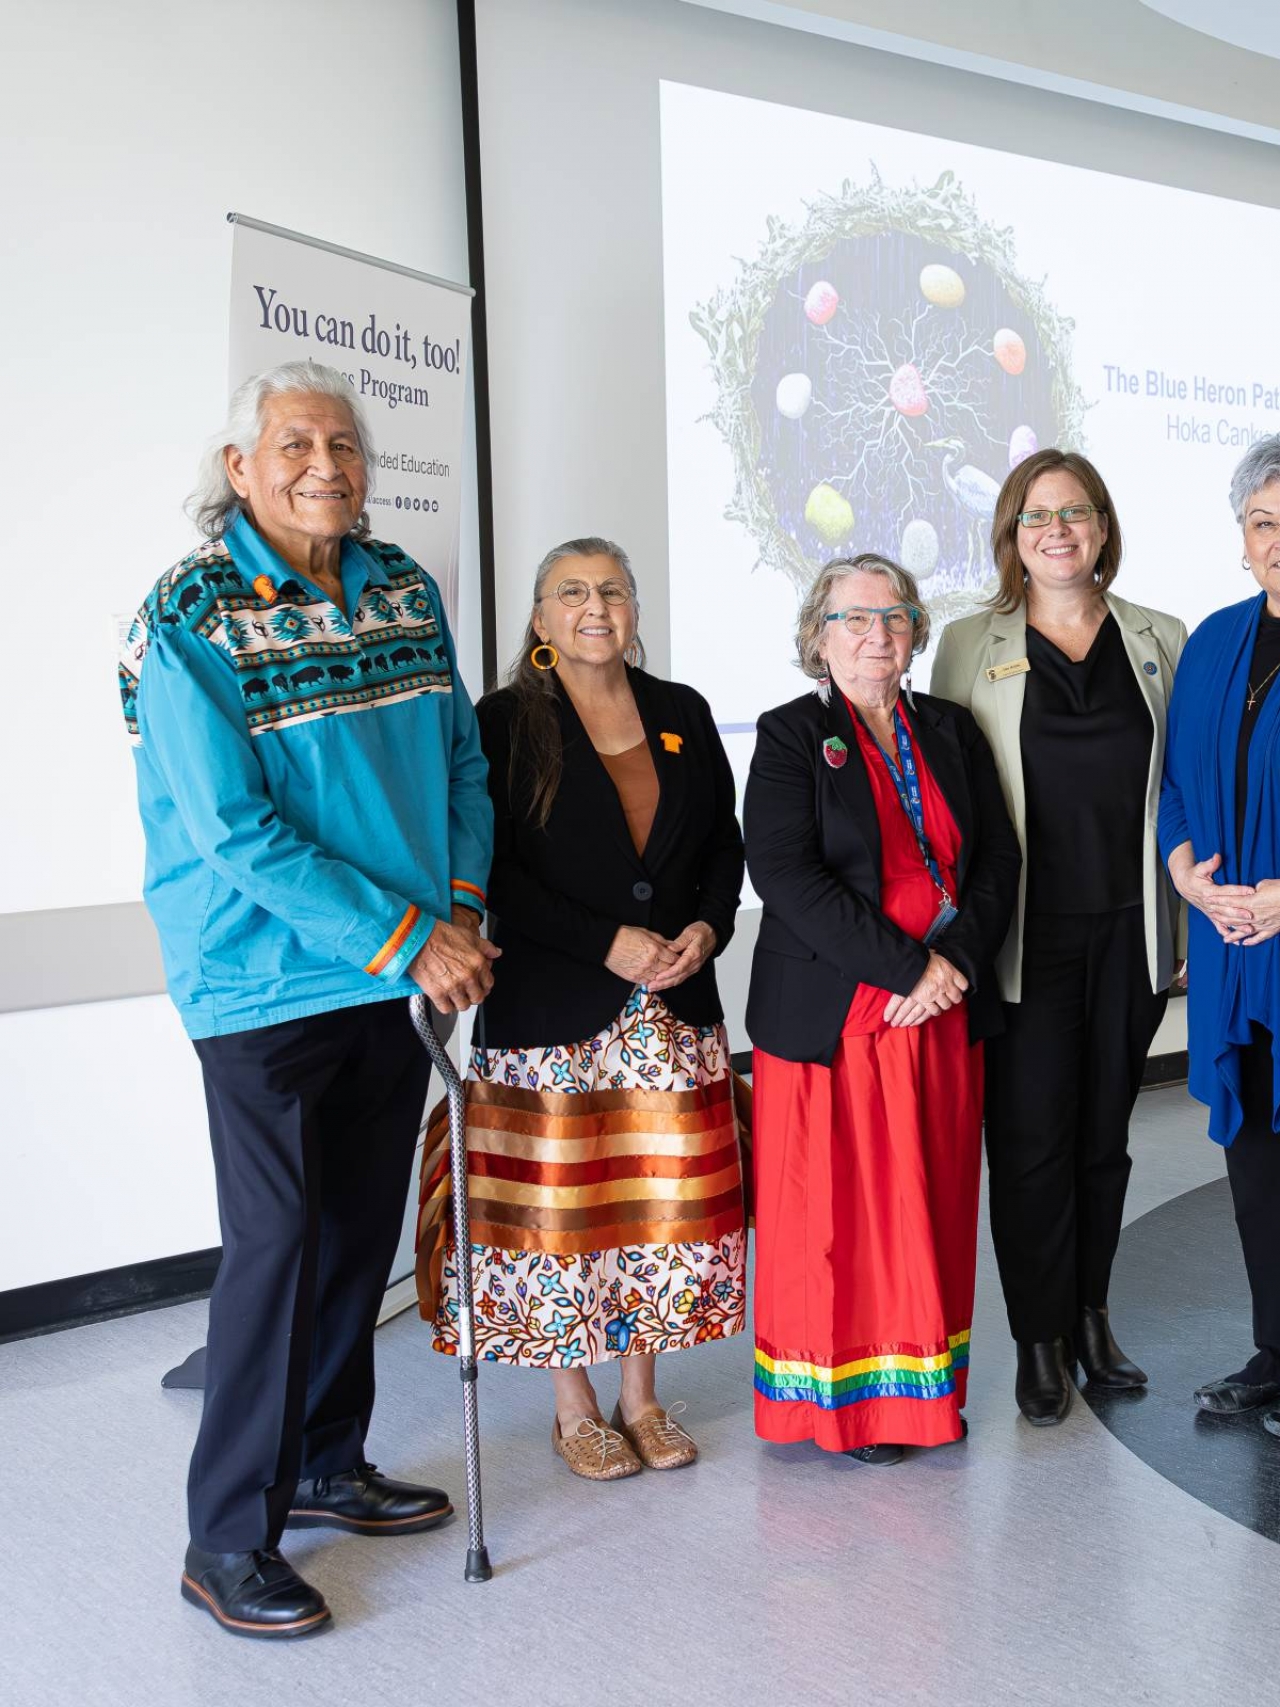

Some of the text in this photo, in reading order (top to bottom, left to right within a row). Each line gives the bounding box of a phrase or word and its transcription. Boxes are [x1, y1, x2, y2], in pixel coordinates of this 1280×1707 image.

[253, 285, 460, 374] You can do it, too!
[360, 368, 429, 409] Program
[1103, 364, 1139, 395] The
[1146, 369, 1187, 400] Blue
[1193, 375, 1247, 407] Heron
[1167, 414, 1211, 444] Hoka
[401, 453, 450, 478] Education
